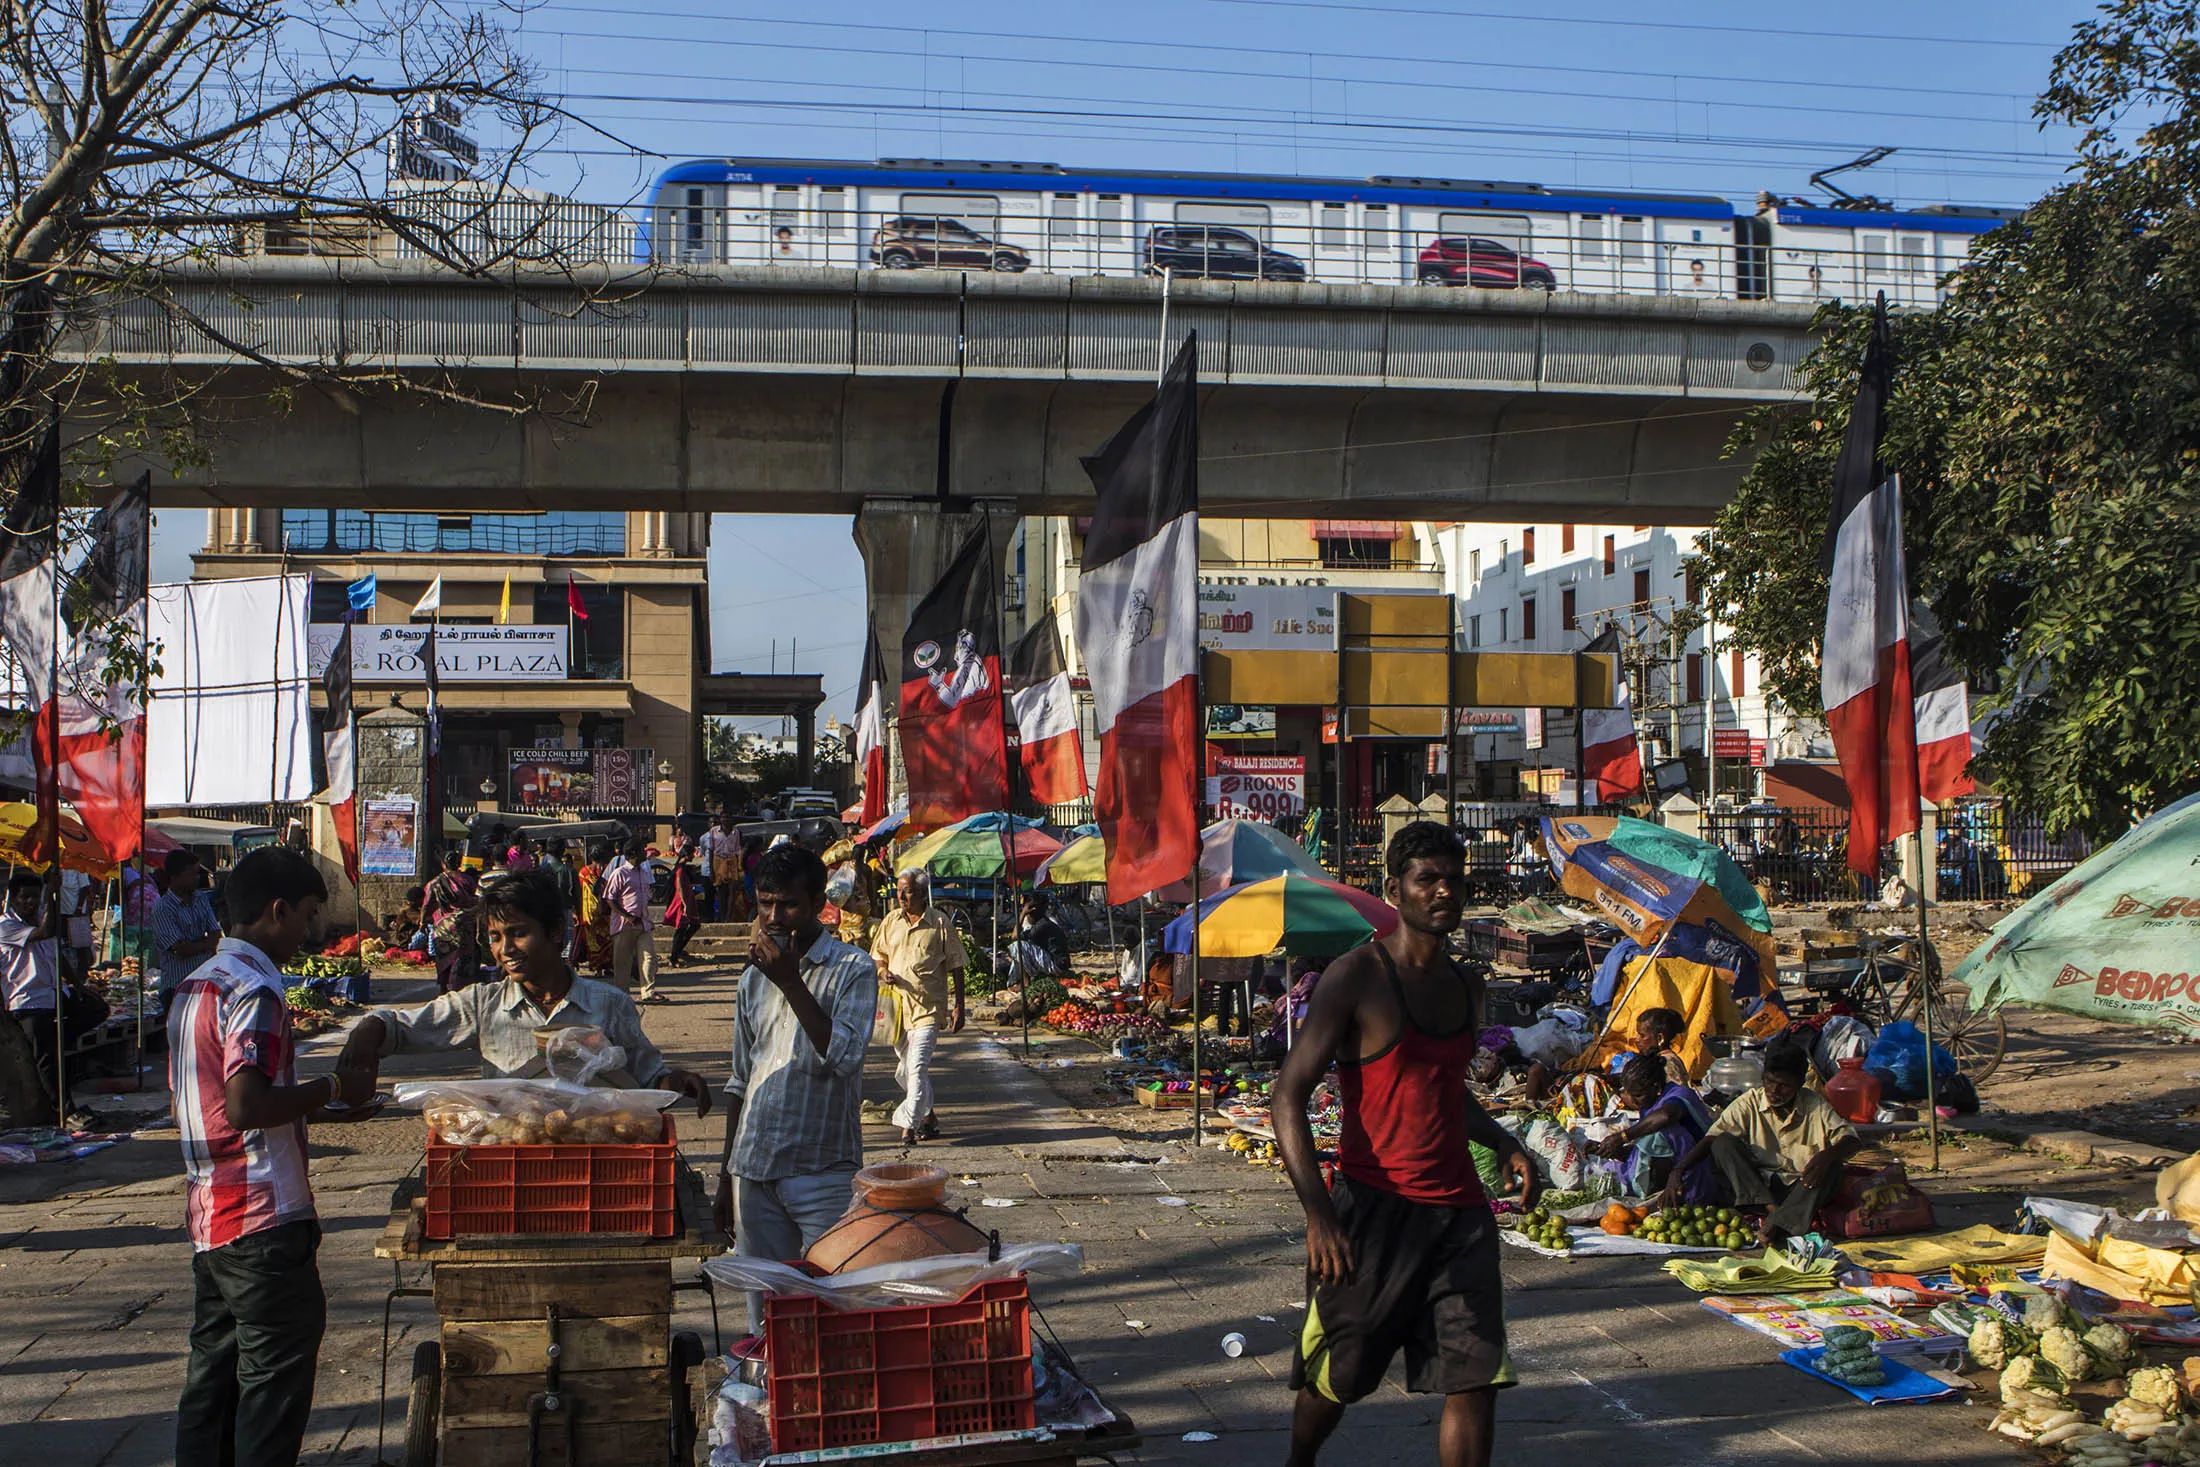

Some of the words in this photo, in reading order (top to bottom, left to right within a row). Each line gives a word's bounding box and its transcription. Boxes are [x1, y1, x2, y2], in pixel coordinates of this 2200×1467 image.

[377, 653, 469, 672] ROAL
[477, 653, 564, 672] PLAZA
[513, 750, 525, 758] ICE
[526, 750, 547, 758] COLD
[548, 750, 569, 758] CHILL
[570, 750, 589, 758] BEER
[1234, 757, 1258, 769] BALAJI
[1259, 757, 1297, 769] RESIDENCY
[1243, 777, 1296, 792] ROOMS
[1621, 909, 1643, 928] FM
[2093, 997, 2120, 1009] TYRES
